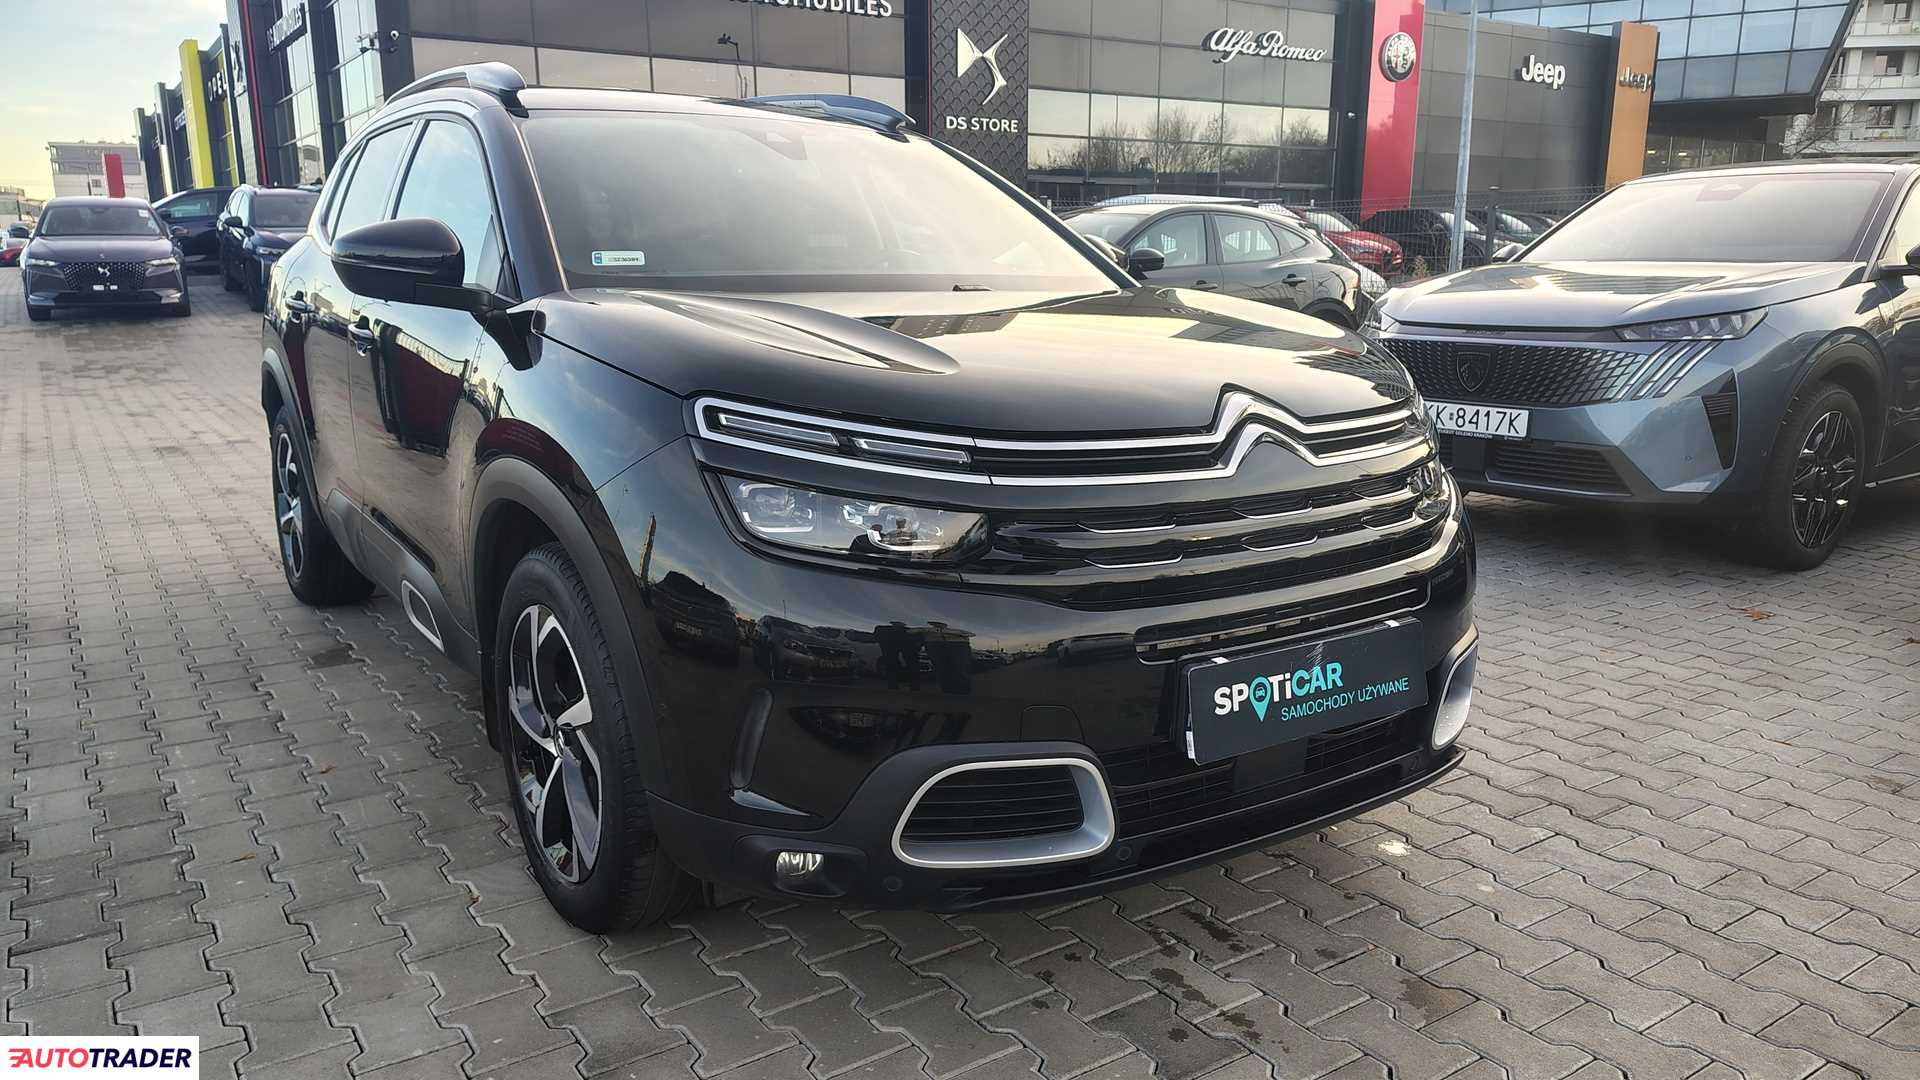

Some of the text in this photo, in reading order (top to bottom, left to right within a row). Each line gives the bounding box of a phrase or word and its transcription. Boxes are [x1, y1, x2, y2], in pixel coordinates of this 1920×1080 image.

[1210, 28, 1328, 63] Alfa Romeo
[1521, 55, 1566, 89] Jeep
[946, 115, 1019, 133] DS STORE
[1455, 407, 1522, 435] 8417K
[1280, 676, 1410, 722] SAMOCHODY UŻYWANE
